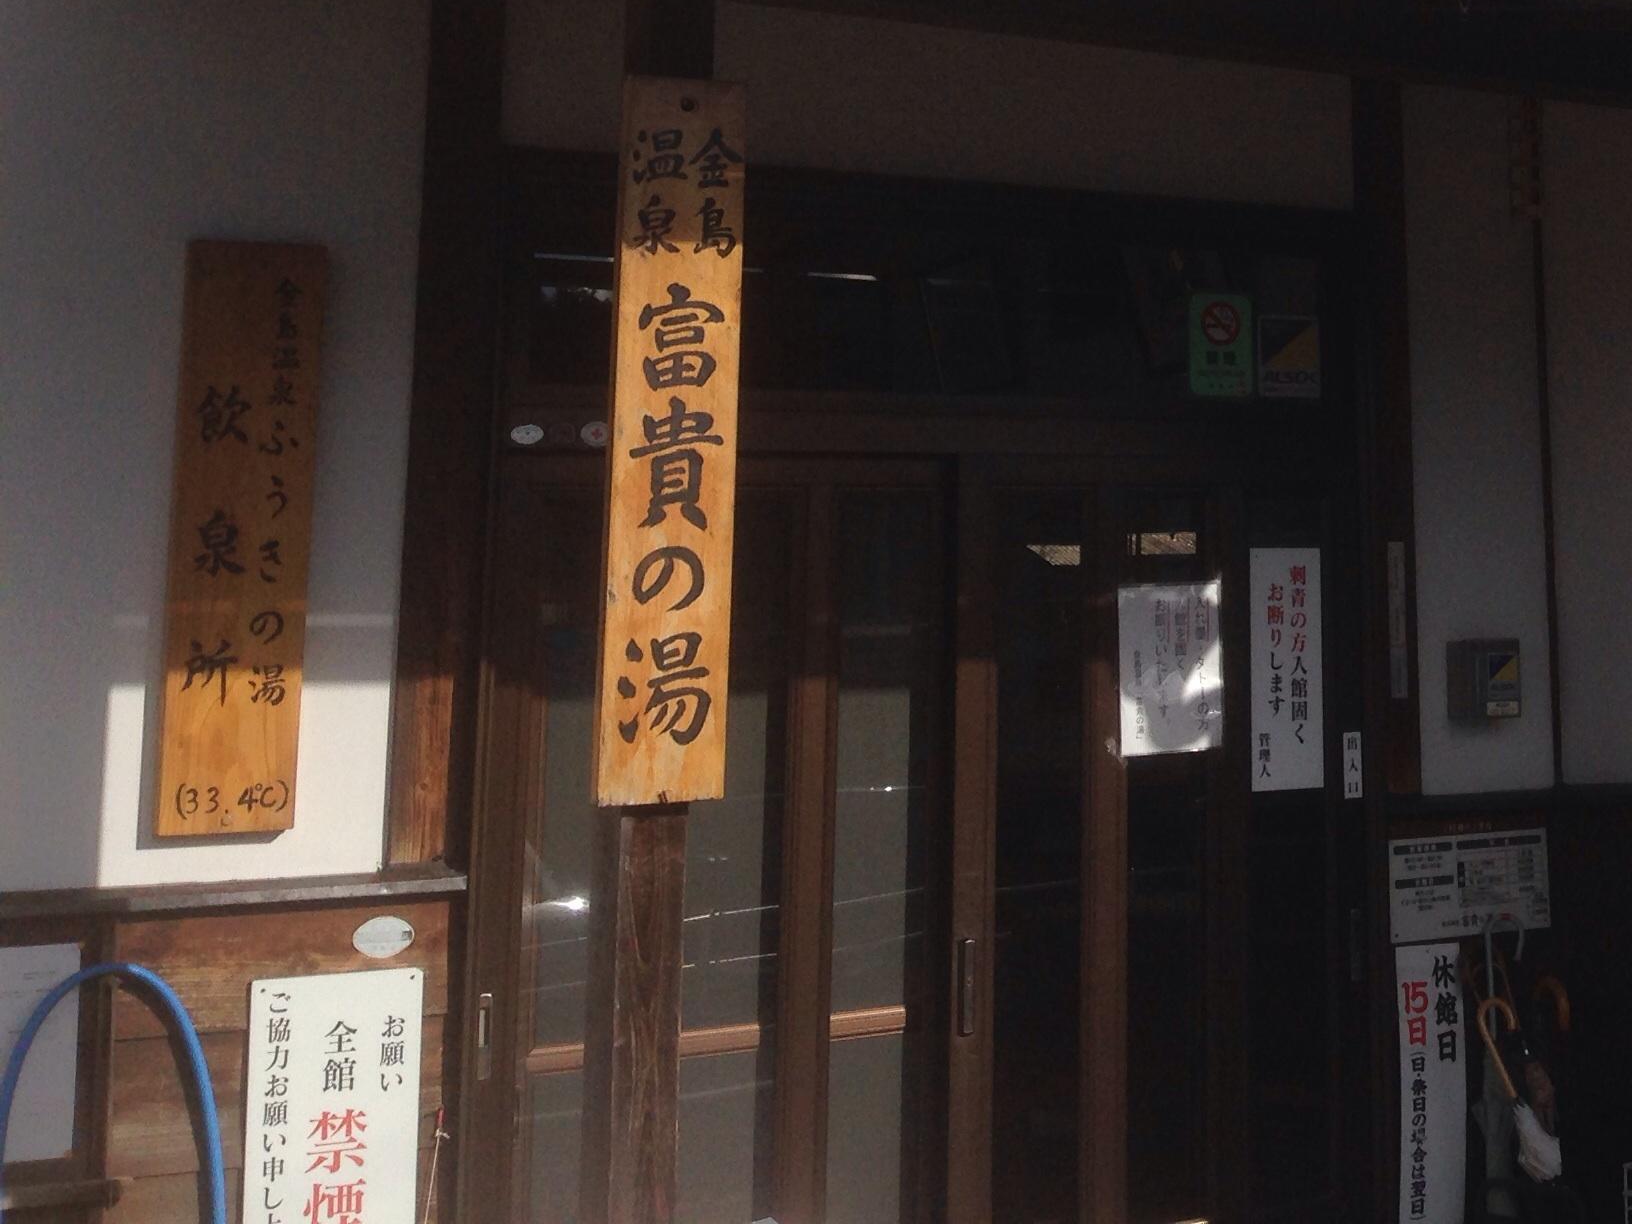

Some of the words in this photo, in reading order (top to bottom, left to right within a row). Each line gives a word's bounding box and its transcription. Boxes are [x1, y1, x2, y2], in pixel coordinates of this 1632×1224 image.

[618, 284, 725, 746] 富貴の湯
[1267, 583, 1286, 718] お断りします
[380, 1015, 406, 1092] お願い
[1432, 955, 1459, 1062] 休館日
